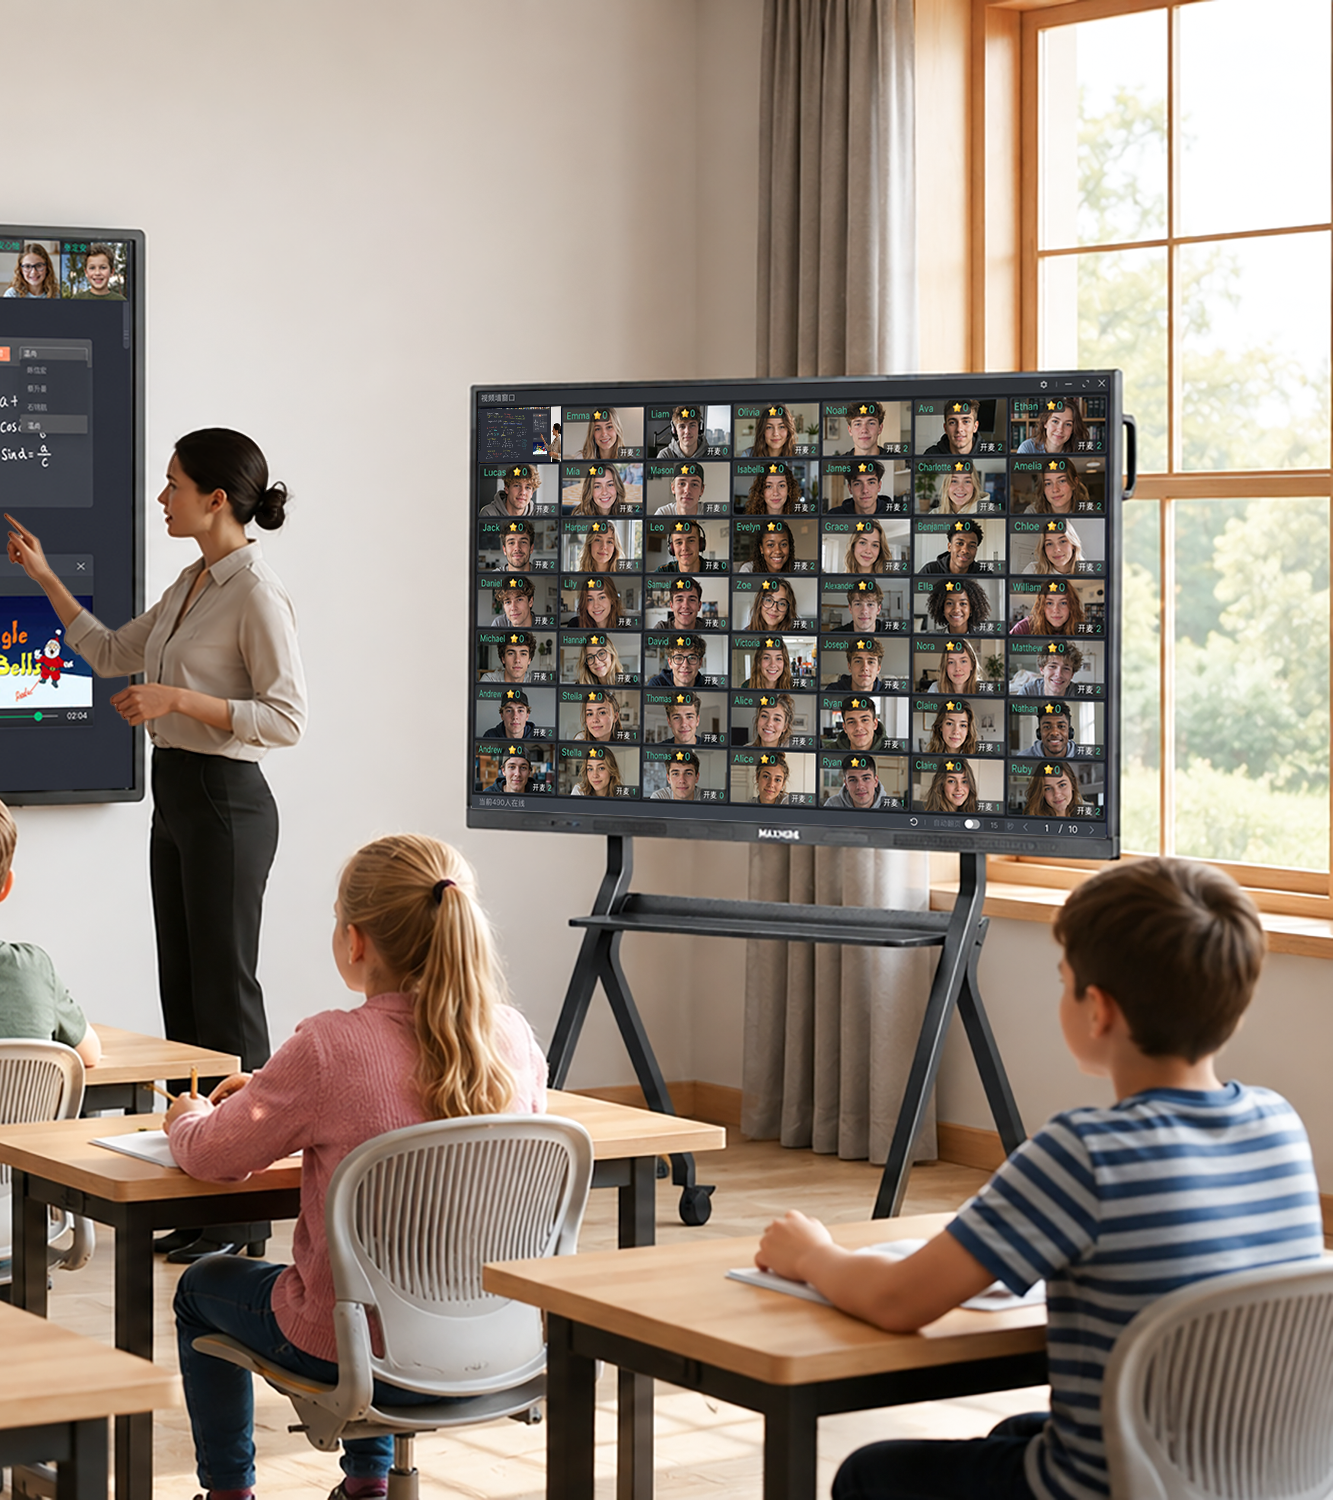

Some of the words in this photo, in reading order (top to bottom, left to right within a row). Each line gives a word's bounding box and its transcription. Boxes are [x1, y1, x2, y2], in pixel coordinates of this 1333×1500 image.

[826, 406, 848, 414] Noah
[1014, 403, 1038, 411] Ethan
[567, 412, 590, 420] Emma
[651, 410, 670, 418] Liam
[738, 408, 760, 417] Olivia
[1097, 442, 1102, 450] 2
[651, 466, 674, 474] Mason
[737, 465, 764, 473] Isabella
[826, 464, 851, 473] James
[918, 463, 951, 471] Charlotte
[1014, 462, 1042, 470] Amelia
[484, 468, 506, 476] Lucas
[565, 523, 588, 533] Harper
[737, 523, 761, 533] Evelyn
[825, 522, 848, 531] Grace
[918, 522, 950, 533] Benjamin
[1015, 522, 1040, 531] Chloe
[481, 579, 502, 587] Daniel
[564, 580, 577, 589] Lily
[647, 580, 671, 588] Samuel
[737, 581, 751, 589] Zoe
[824, 582, 854, 590] Alexander
[918, 582, 933, 591] Ella
[1013, 583, 1041, 591] William
[480, 634, 506, 643] Michael
[563, 636, 587, 644] Hannah
[648, 637, 668, 646] David
[735, 639, 760, 647] Victoria
[824, 640, 849, 650] Joseph
[917, 642, 934, 650] Nora
[1012, 643, 1043, 652] Matthew
[479, 689, 502, 698] Andrew
[562, 692, 582, 700] Stella
[647, 694, 672, 702] Thomas
[735, 696, 753, 705] Alice
[823, 699, 842, 708] Ryan
[917, 701, 938, 710] Claire
[1012, 704, 1038, 713] Nathan
[646, 751, 671, 760] Thomas
[734, 755, 753, 763] Alice
[823, 757, 842, 767] Ryan
[916, 761, 937, 770] Claire
[1012, 765, 1033, 775] Ruby
[1095, 807, 1100, 815] 2
[1068, 825, 1078, 833] 10
